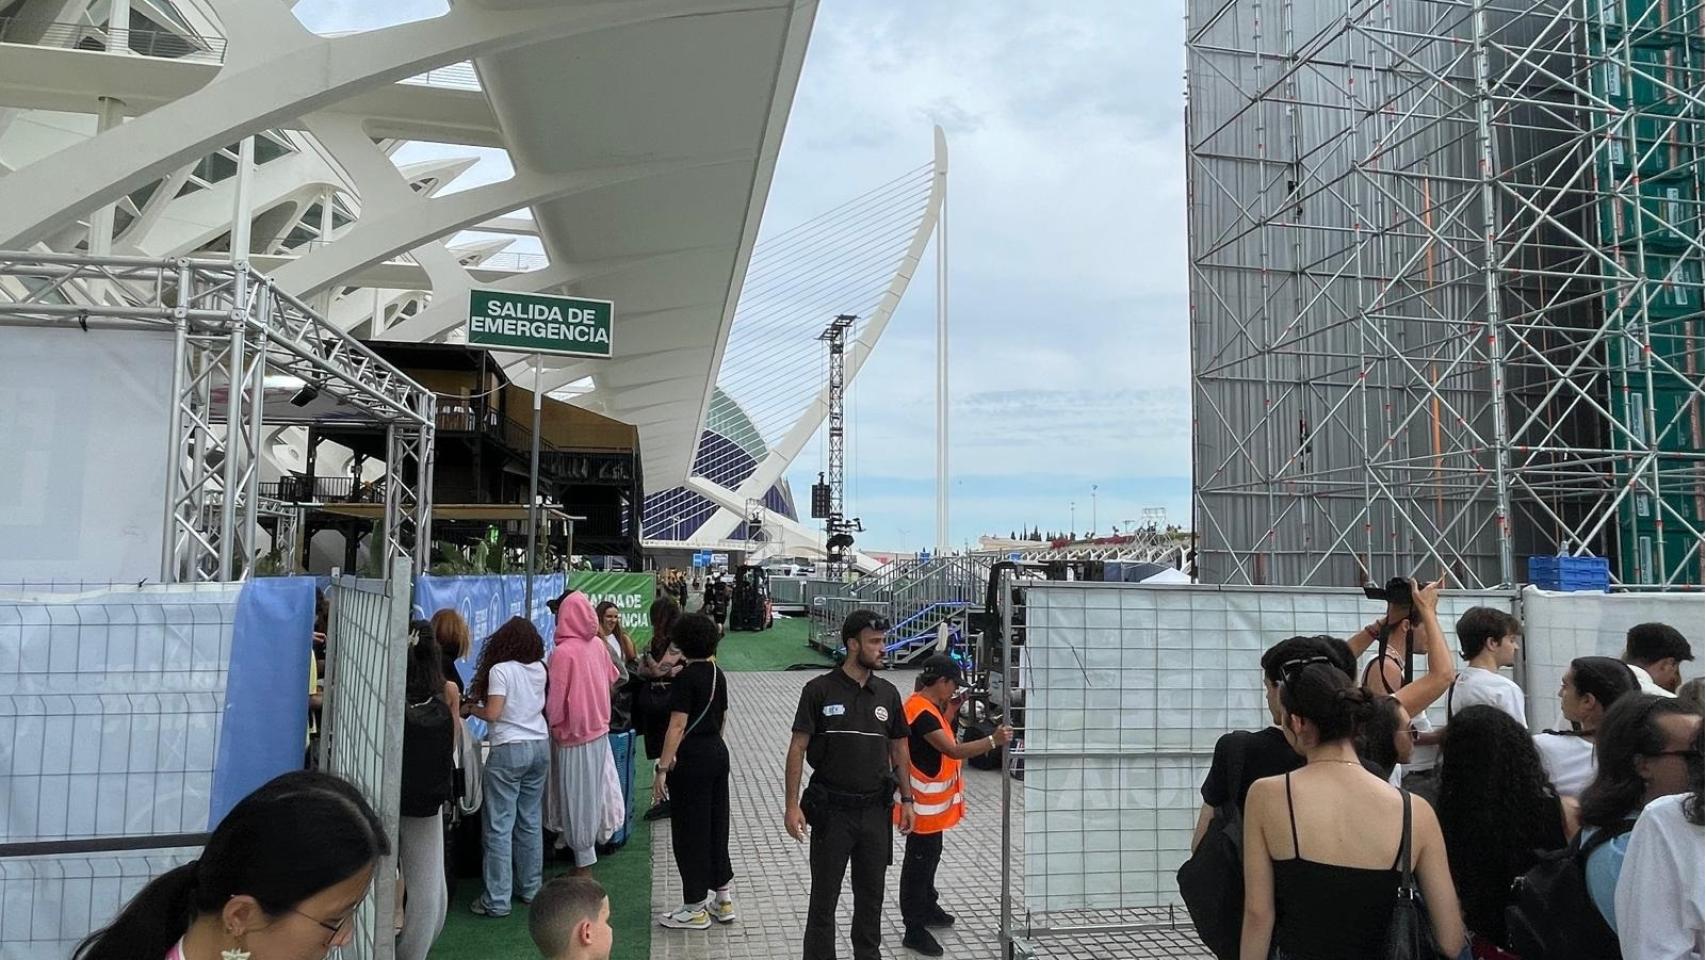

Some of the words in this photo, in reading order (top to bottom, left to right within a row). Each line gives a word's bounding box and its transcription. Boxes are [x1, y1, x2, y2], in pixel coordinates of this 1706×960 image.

[487, 300, 563, 322] SALIDA
[568, 308, 596, 325] DE
[471, 316, 609, 343] EMERGENCIA
[625, 594, 642, 608] DE
